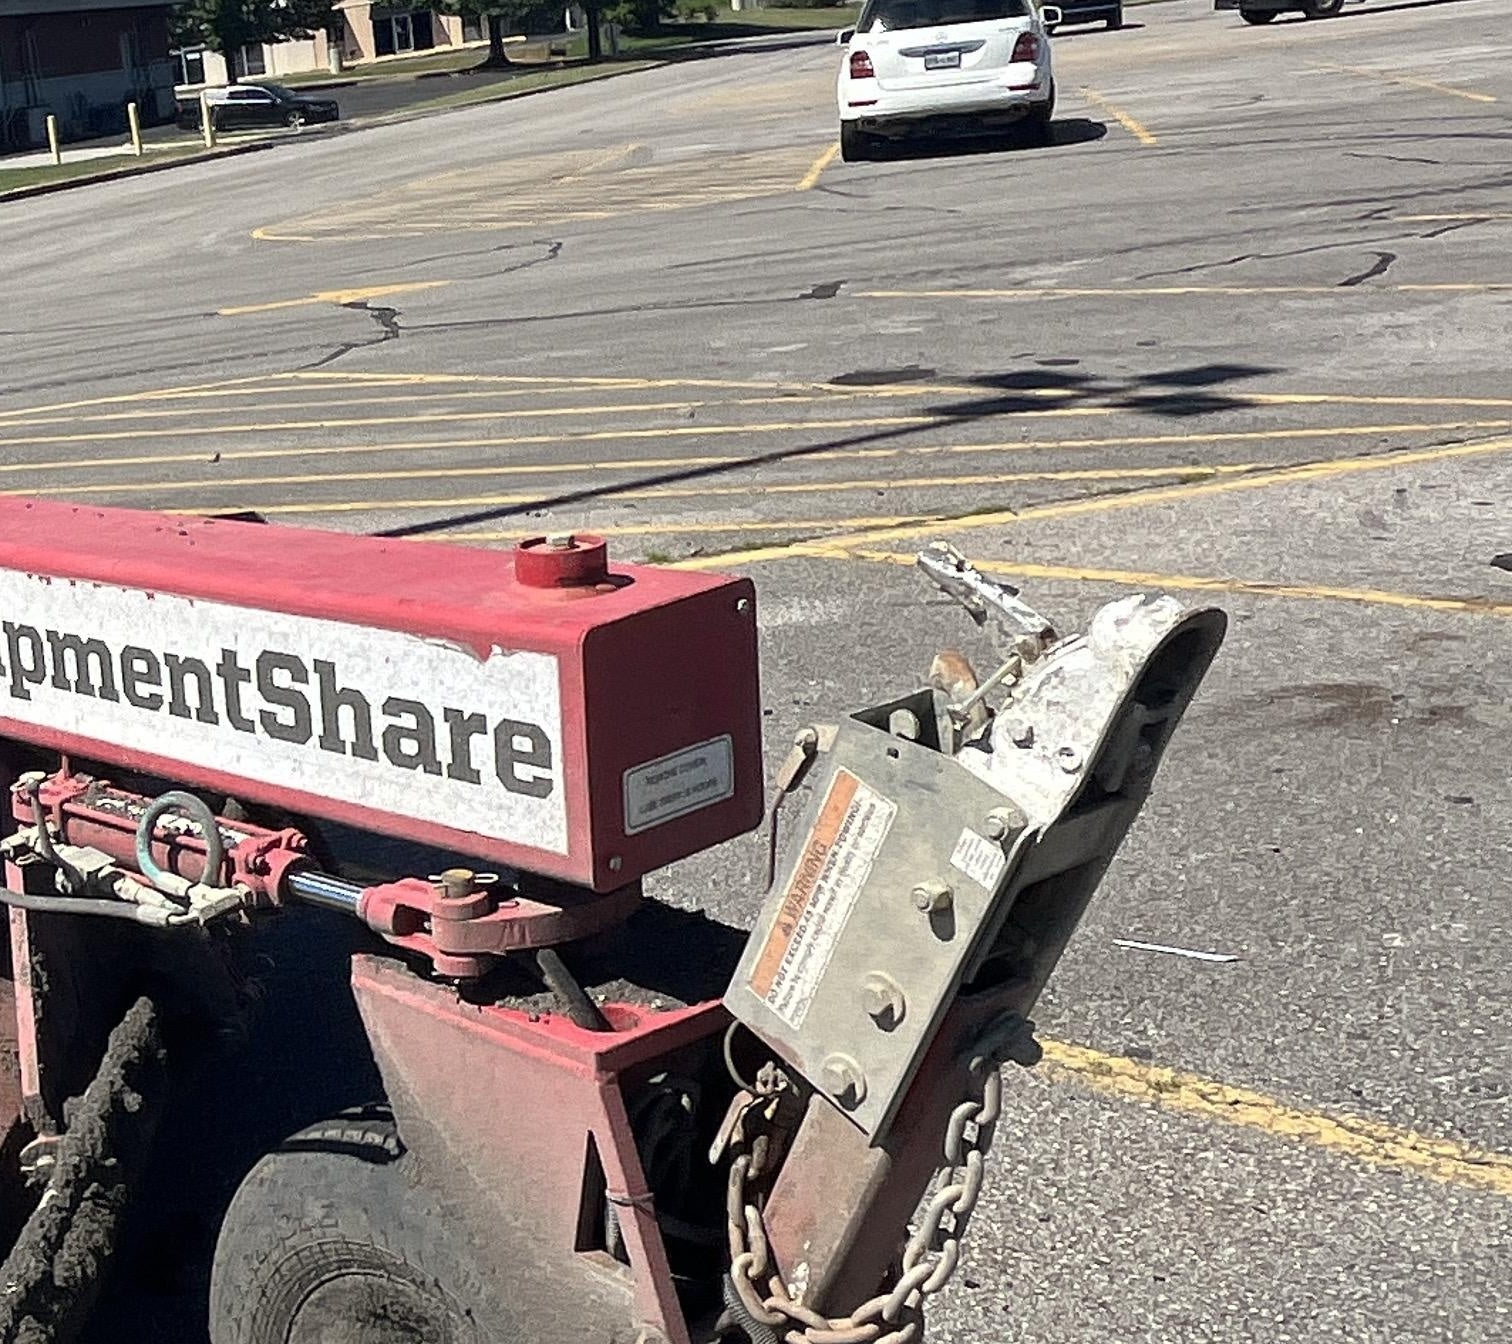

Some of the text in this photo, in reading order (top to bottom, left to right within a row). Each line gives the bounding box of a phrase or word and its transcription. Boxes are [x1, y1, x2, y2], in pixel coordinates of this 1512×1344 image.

[786, 841, 830, 921] WARNING
[767, 987, 778, 1005] DO
[774, 964, 788, 989] NOT
[784, 921, 807, 966] EXCEED
